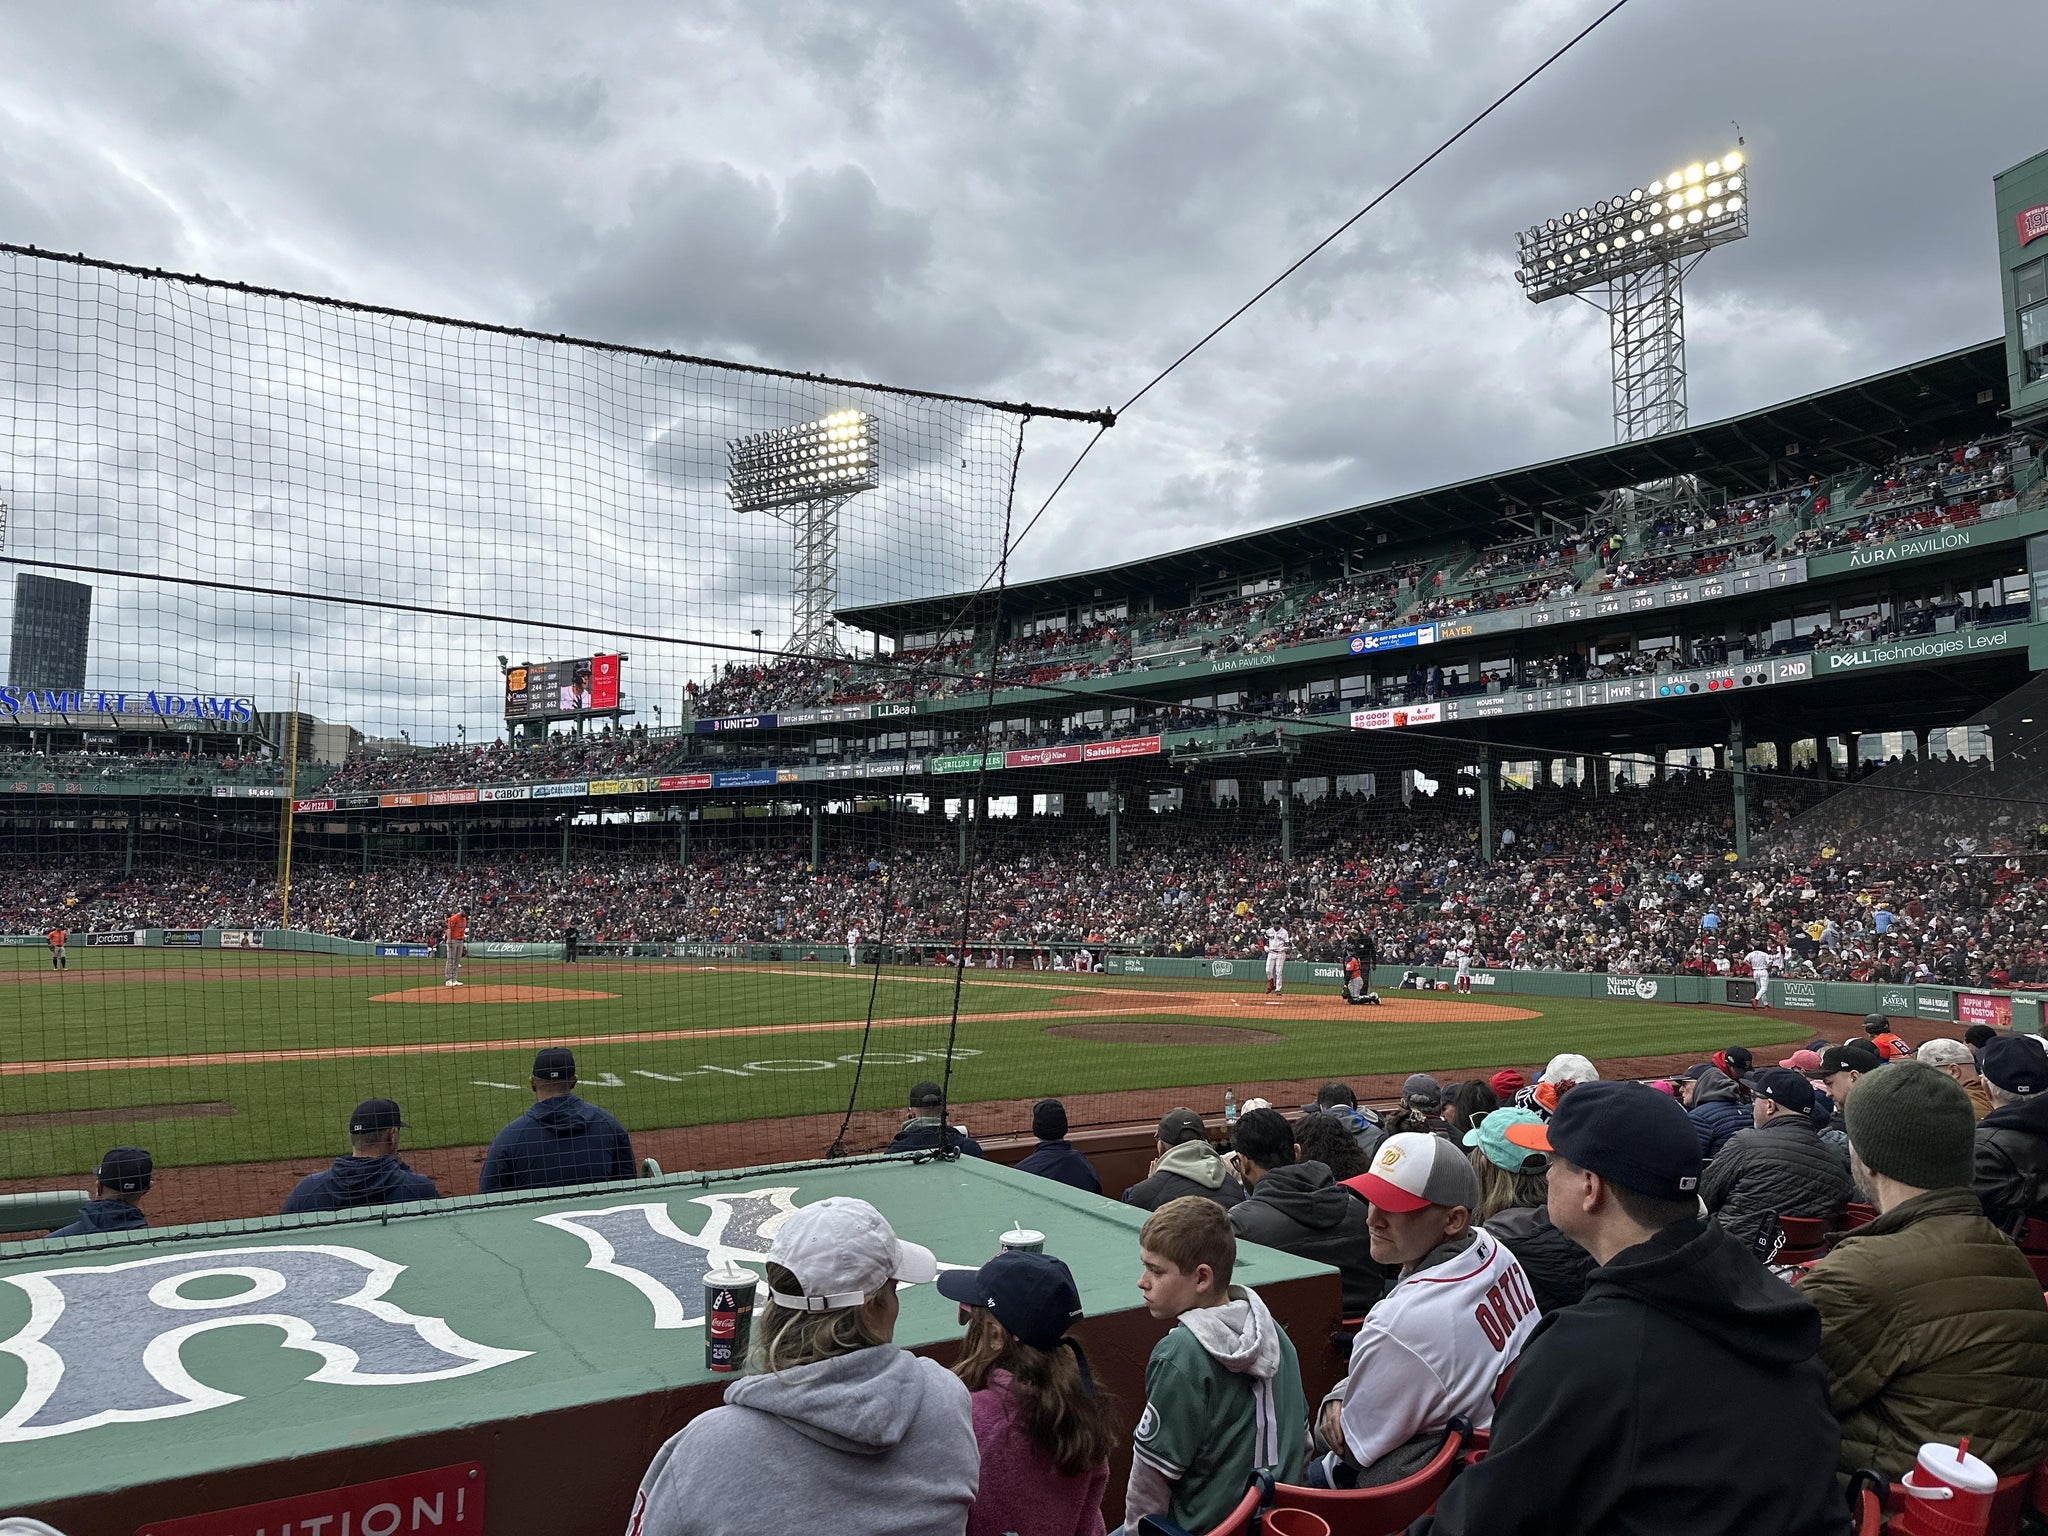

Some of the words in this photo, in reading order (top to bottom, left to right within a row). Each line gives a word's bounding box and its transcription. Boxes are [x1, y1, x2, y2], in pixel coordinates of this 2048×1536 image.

[1901, 532, 1970, 557] PAVILION
[1780, 573, 1786, 583] 7
[1671, 583, 1683, 591] SLG
[1702, 585, 1723, 598] .662
[1667, 591, 1689, 604] .354
[1598, 602, 1619, 614] .244
[1632, 597, 1653, 610] .308
[1537, 613, 1549, 623] 29
[1569, 608, 1581, 618] 92
[1441, 625, 1473, 638] MAYER
[1831, 651, 1872, 669] DELL
[1872, 637, 1964, 663] Technologies
[1968, 630, 2007, 649] Level
[1239, 654, 1276, 668] PAVILION
[1705, 668, 1736, 680] STRIKE
[1745, 664, 1764, 674] OUT
[1780, 662, 1807, 678] 2ND
[1638, 680, 1645, 689] 4
[1667, 675, 1692, 685] BALL
[1476, 697, 1504, 707] HOUSTON
[1527, 693, 1533, 701] 0
[1546, 691, 1552, 699] 2
[1566, 689, 1572, 697] 0
[1591, 685, 1598, 694] 2
[1610, 686, 1632, 698] MVR
[1638, 690, 1645, 699] 4
[0, 685, 134, 717] SAMUEL
[140, 690, 251, 724] ADAMS
[1448, 702, 1458, 711] 67
[1478, 706, 1503, 716] BOSTON
[1527, 703, 1533, 711] 0
[1566, 699, 1572, 707] 0
[1591, 695, 1598, 704] 2
[1354, 714, 1364, 722] SO
[1366, 711, 1390, 720] GOOD!
[1448, 711, 1458, 720] 55
[723, 718, 760, 730] UNITED
[1366, 719, 1390, 727] GOOD!
[1020, 754, 1041, 762] Ninety
[1051, 752, 1067, 760] Nine
[1085, 746, 1122, 758] Safelite
[93, 783, 107, 794] 42
[394, 796, 413, 804] STIHL
[494, 789, 525, 800] CABOT
[311, 801, 329, 810] PIZZA
[384, 948, 399, 956] ZOLL
[1606, 976, 1637, 987] Ninety
[1606, 985, 1636, 996] Nine
[1783, 982, 1816, 996] WM
[1882, 996, 1909, 1008] KAYEM
[1984, 999, 1992, 1008] UP
[1962, 1006, 1971, 1015] TO
[1971, 1008, 1995, 1018] BOSTON
[1474, 1262, 1536, 1353] ORTIZ
[712, 1348, 732, 1360] 250
